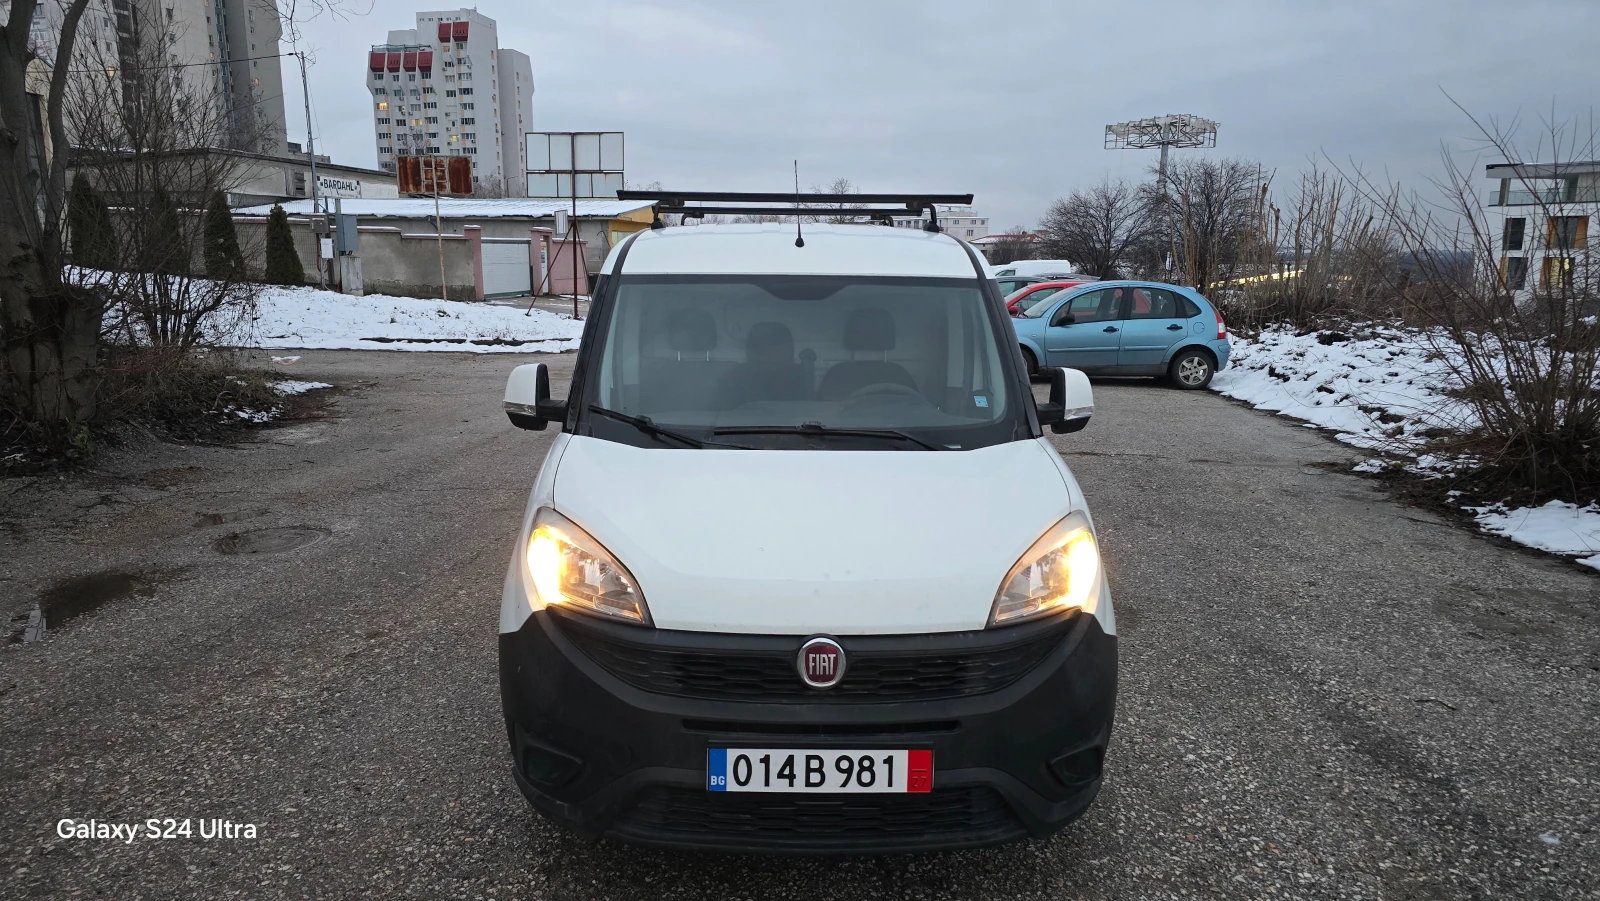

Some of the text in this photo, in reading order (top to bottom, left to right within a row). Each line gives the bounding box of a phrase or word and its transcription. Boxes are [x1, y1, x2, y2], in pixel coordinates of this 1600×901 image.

[323, 179, 354, 191] BARDAHL
[808, 654, 836, 675] FIAT
[710, 775, 725, 786] BG
